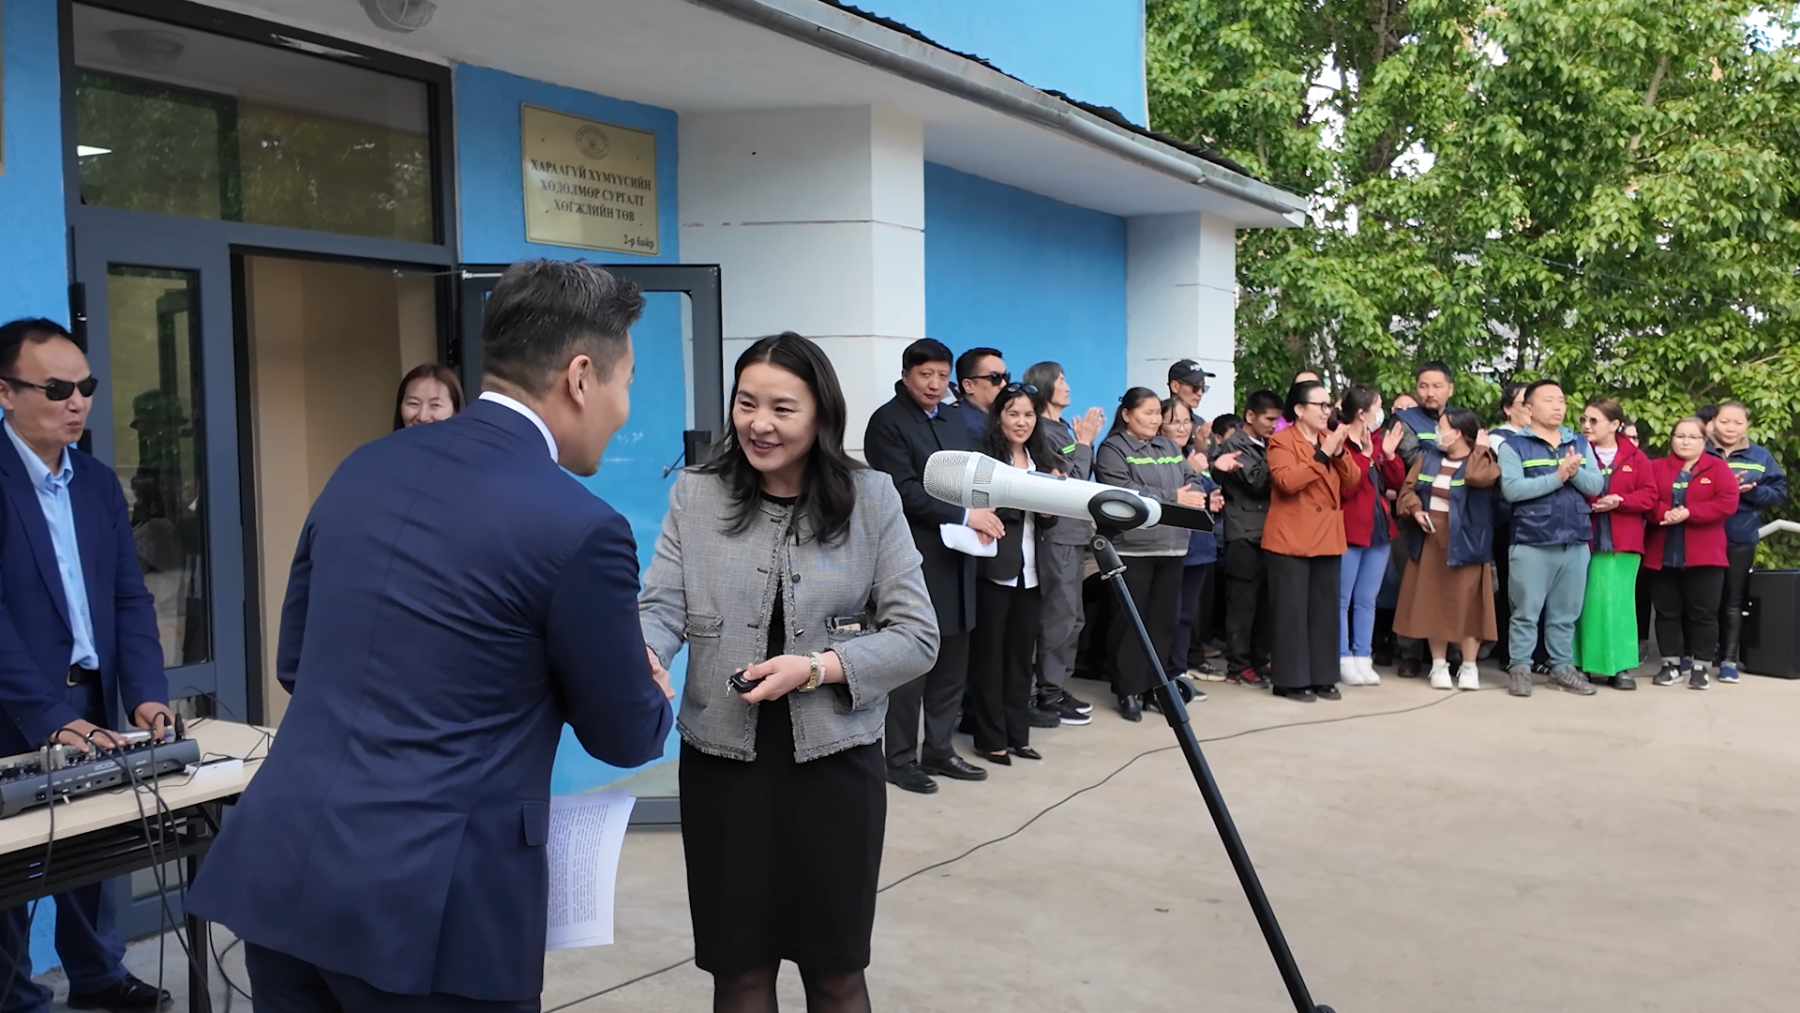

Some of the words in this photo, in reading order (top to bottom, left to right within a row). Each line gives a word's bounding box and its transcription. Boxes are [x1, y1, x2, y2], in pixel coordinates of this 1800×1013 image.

[531, 158, 586, 179] ХАРААГҮЙ
[588, 169, 651, 191] ХҮМҮҮСИЙН
[540, 179, 600, 199] ХӨДӨЛМӨР
[602, 189, 644, 206] СУРГАЛТ
[554, 199, 614, 219] ХӨГЖЛИЙН
[615, 208, 635, 222] ТӨВ
